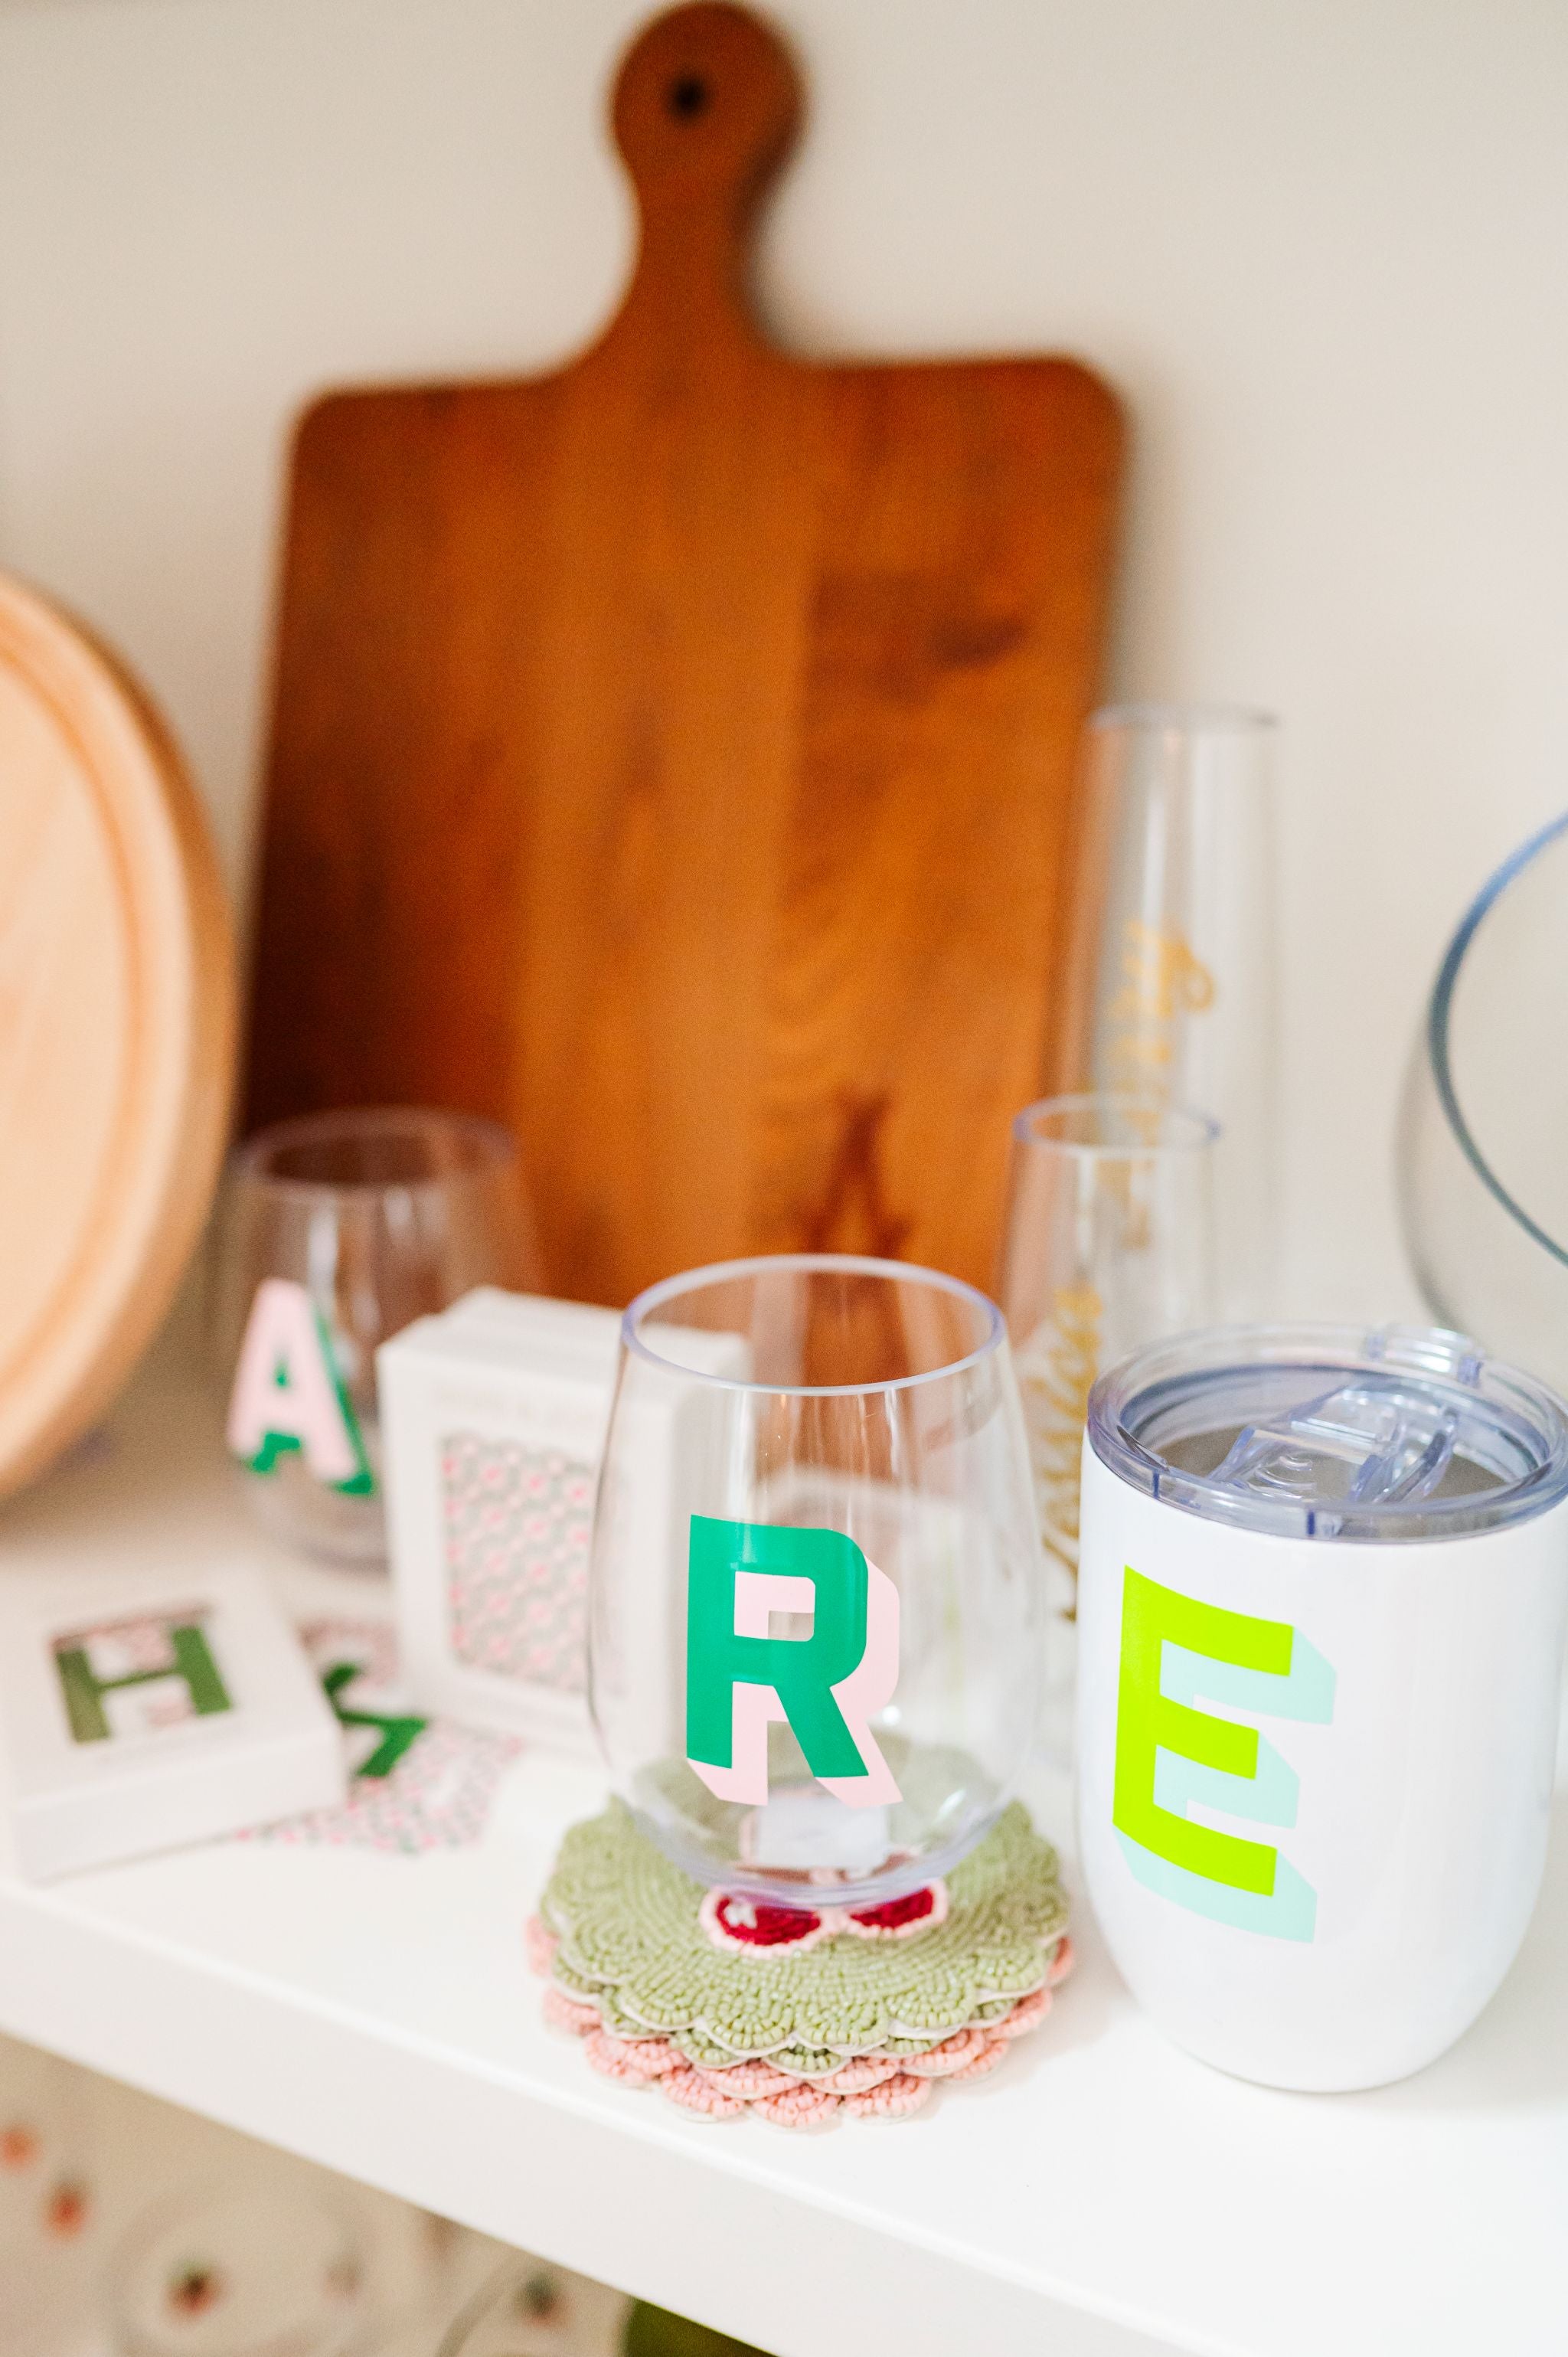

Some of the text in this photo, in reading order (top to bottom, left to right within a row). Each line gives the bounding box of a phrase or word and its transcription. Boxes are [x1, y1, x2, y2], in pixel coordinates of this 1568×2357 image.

[230, 1277, 375, 1496] A
[54, 1624, 234, 1744] H
[687, 1514, 903, 1808] R
[1112, 1564, 1337, 1943] E
